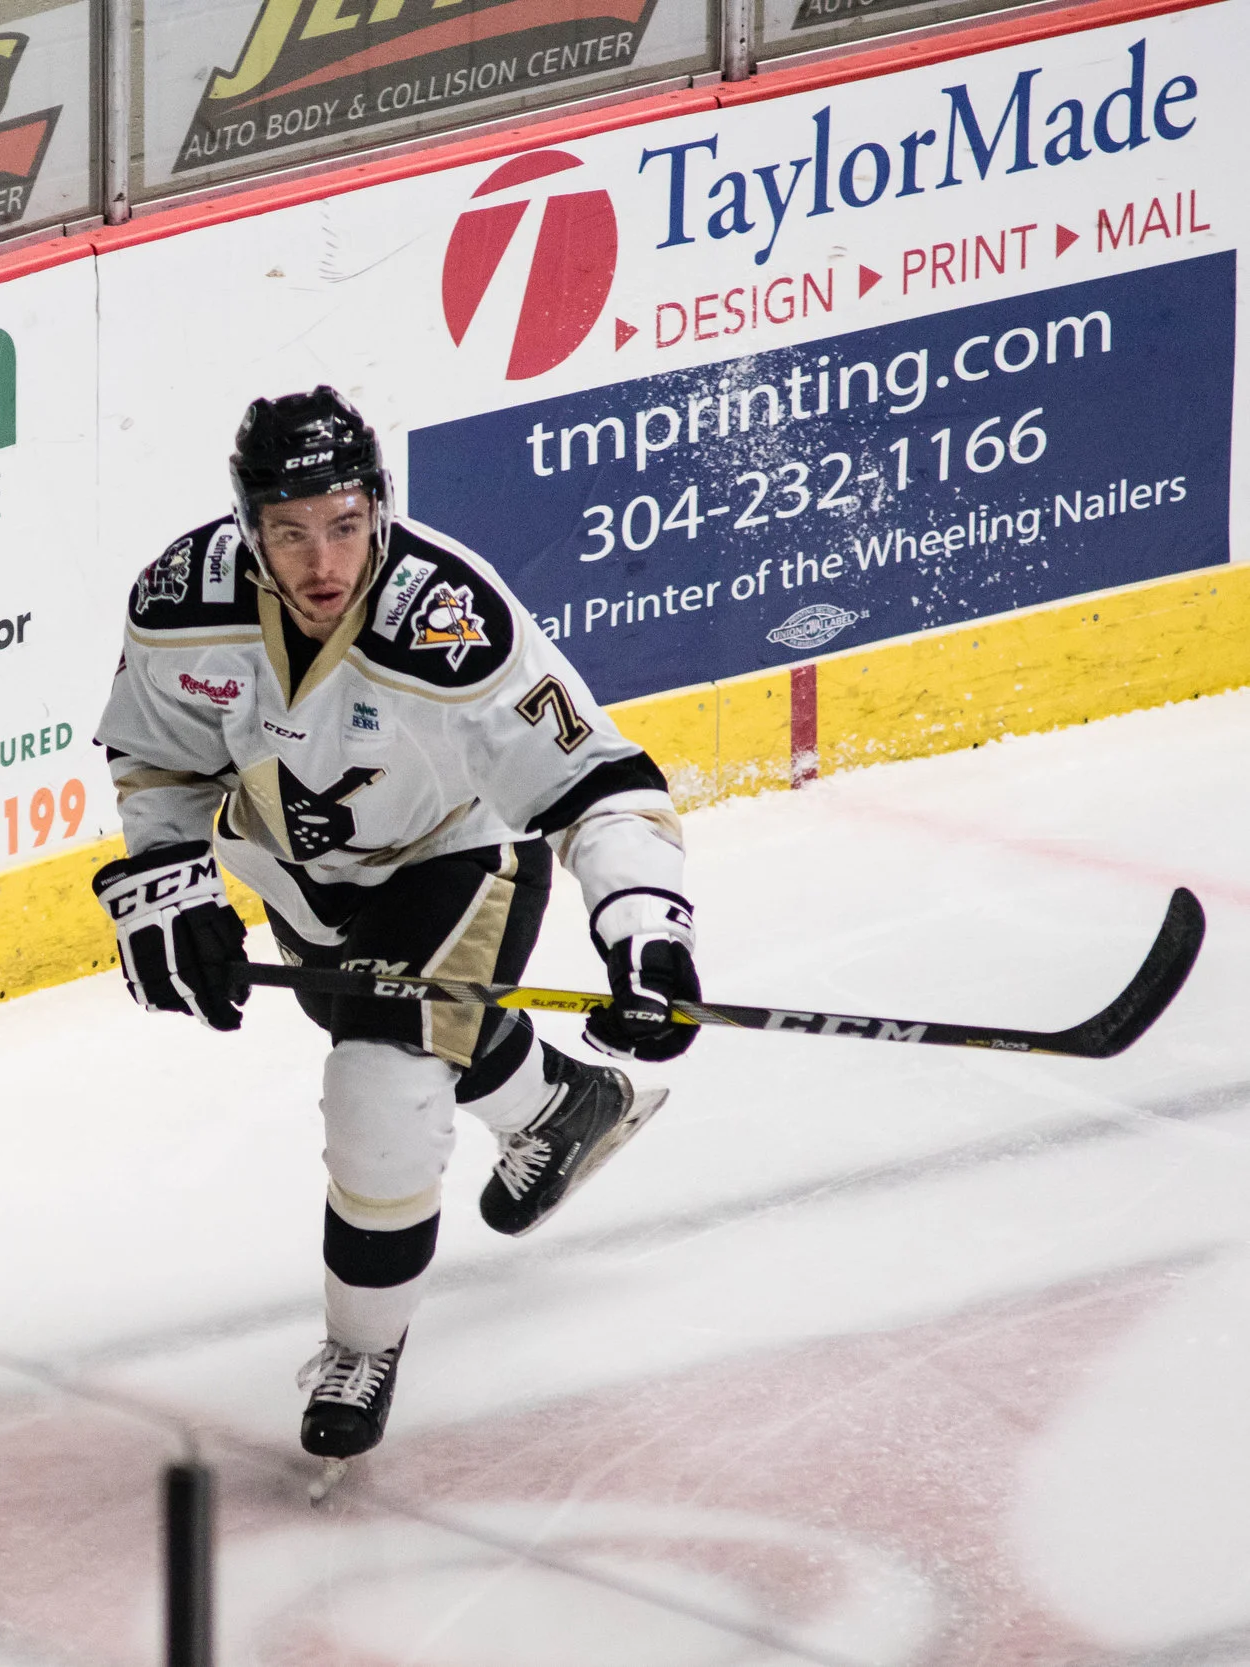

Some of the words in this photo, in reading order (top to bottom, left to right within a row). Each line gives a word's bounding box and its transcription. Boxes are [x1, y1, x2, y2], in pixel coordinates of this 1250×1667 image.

[185, 121, 256, 159] AUTO
[266, 103, 336, 140] BODY
[347, 93, 364, 119] &
[378, 58, 517, 114] COLLISION
[527, 31, 634, 79] CENTER
[639, 37, 1198, 266] TaylorMade
[655, 268, 834, 349] DESIGN
[903, 223, 1038, 296] PRINT
[1096, 189, 1210, 253] MAIL
[525, 310, 1112, 478] tmprinting.com
[286, 451, 333, 470] CCM
[579, 407, 1048, 562] 304-232-1166
[208, 534, 233, 583] Gulfport
[531, 604, 571, 640] al
[586, 580, 721, 633] Printer
[731, 559, 772, 600] of
[779, 546, 843, 589] the
[854, 502, 1042, 570] Wheeling
[1055, 474, 1187, 530] Nailers
[385, 567, 429, 627] WesBanco
[773, 624, 803, 641] UNION
[824, 615, 852, 629] LABEL
[263, 719, 307, 741] CCM
[515, 673, 593, 754] 7
[108, 857, 218, 920] CCM
[340, 959, 409, 976] CM
[531, 999, 578, 1010] SUPER
[623, 1010, 666, 1023] CCM
[763, 1009, 928, 1043] CCM
